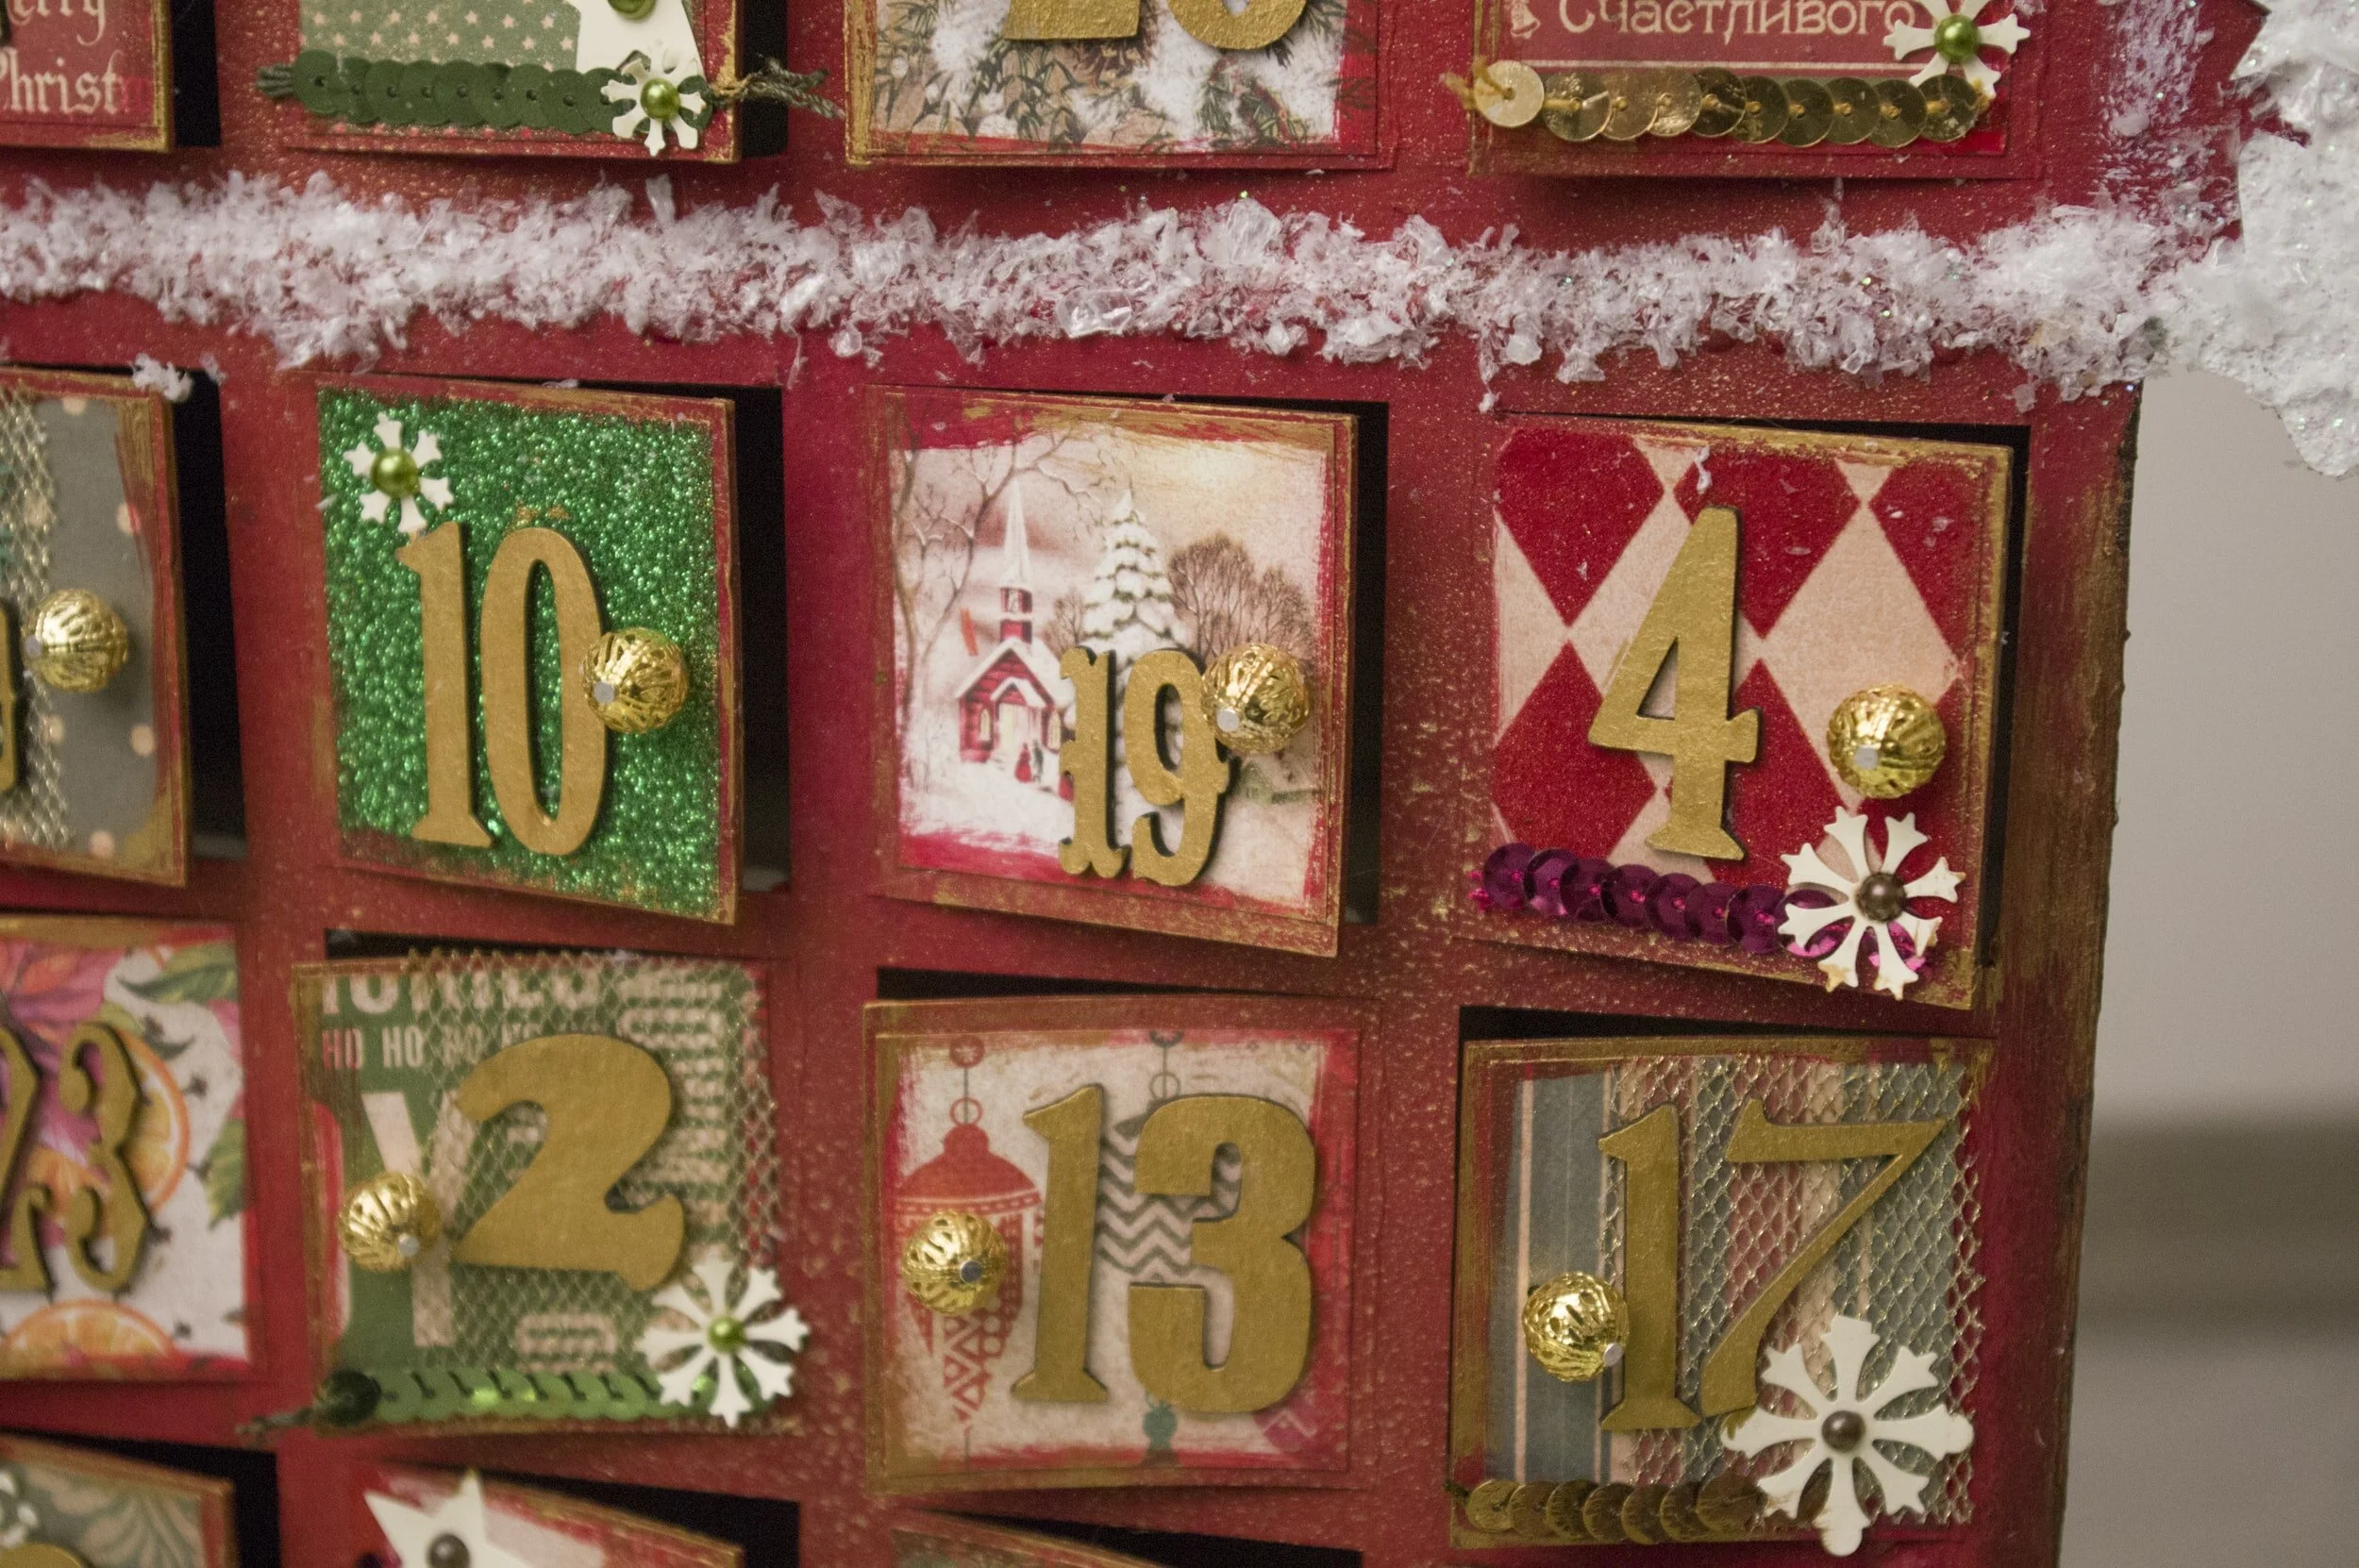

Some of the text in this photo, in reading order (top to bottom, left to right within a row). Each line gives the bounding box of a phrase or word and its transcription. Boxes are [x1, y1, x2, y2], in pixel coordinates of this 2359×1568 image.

[395, 522, 608, 856] 10
[1060, 646, 1230, 887] 19
[1589, 506, 1760, 859] 4
[382, 1025, 424, 1069] HO
[453, 1033, 685, 1292] 2
[1012, 1083, 1316, 1415] 13
[1598, 1096, 1947, 1429] 17
